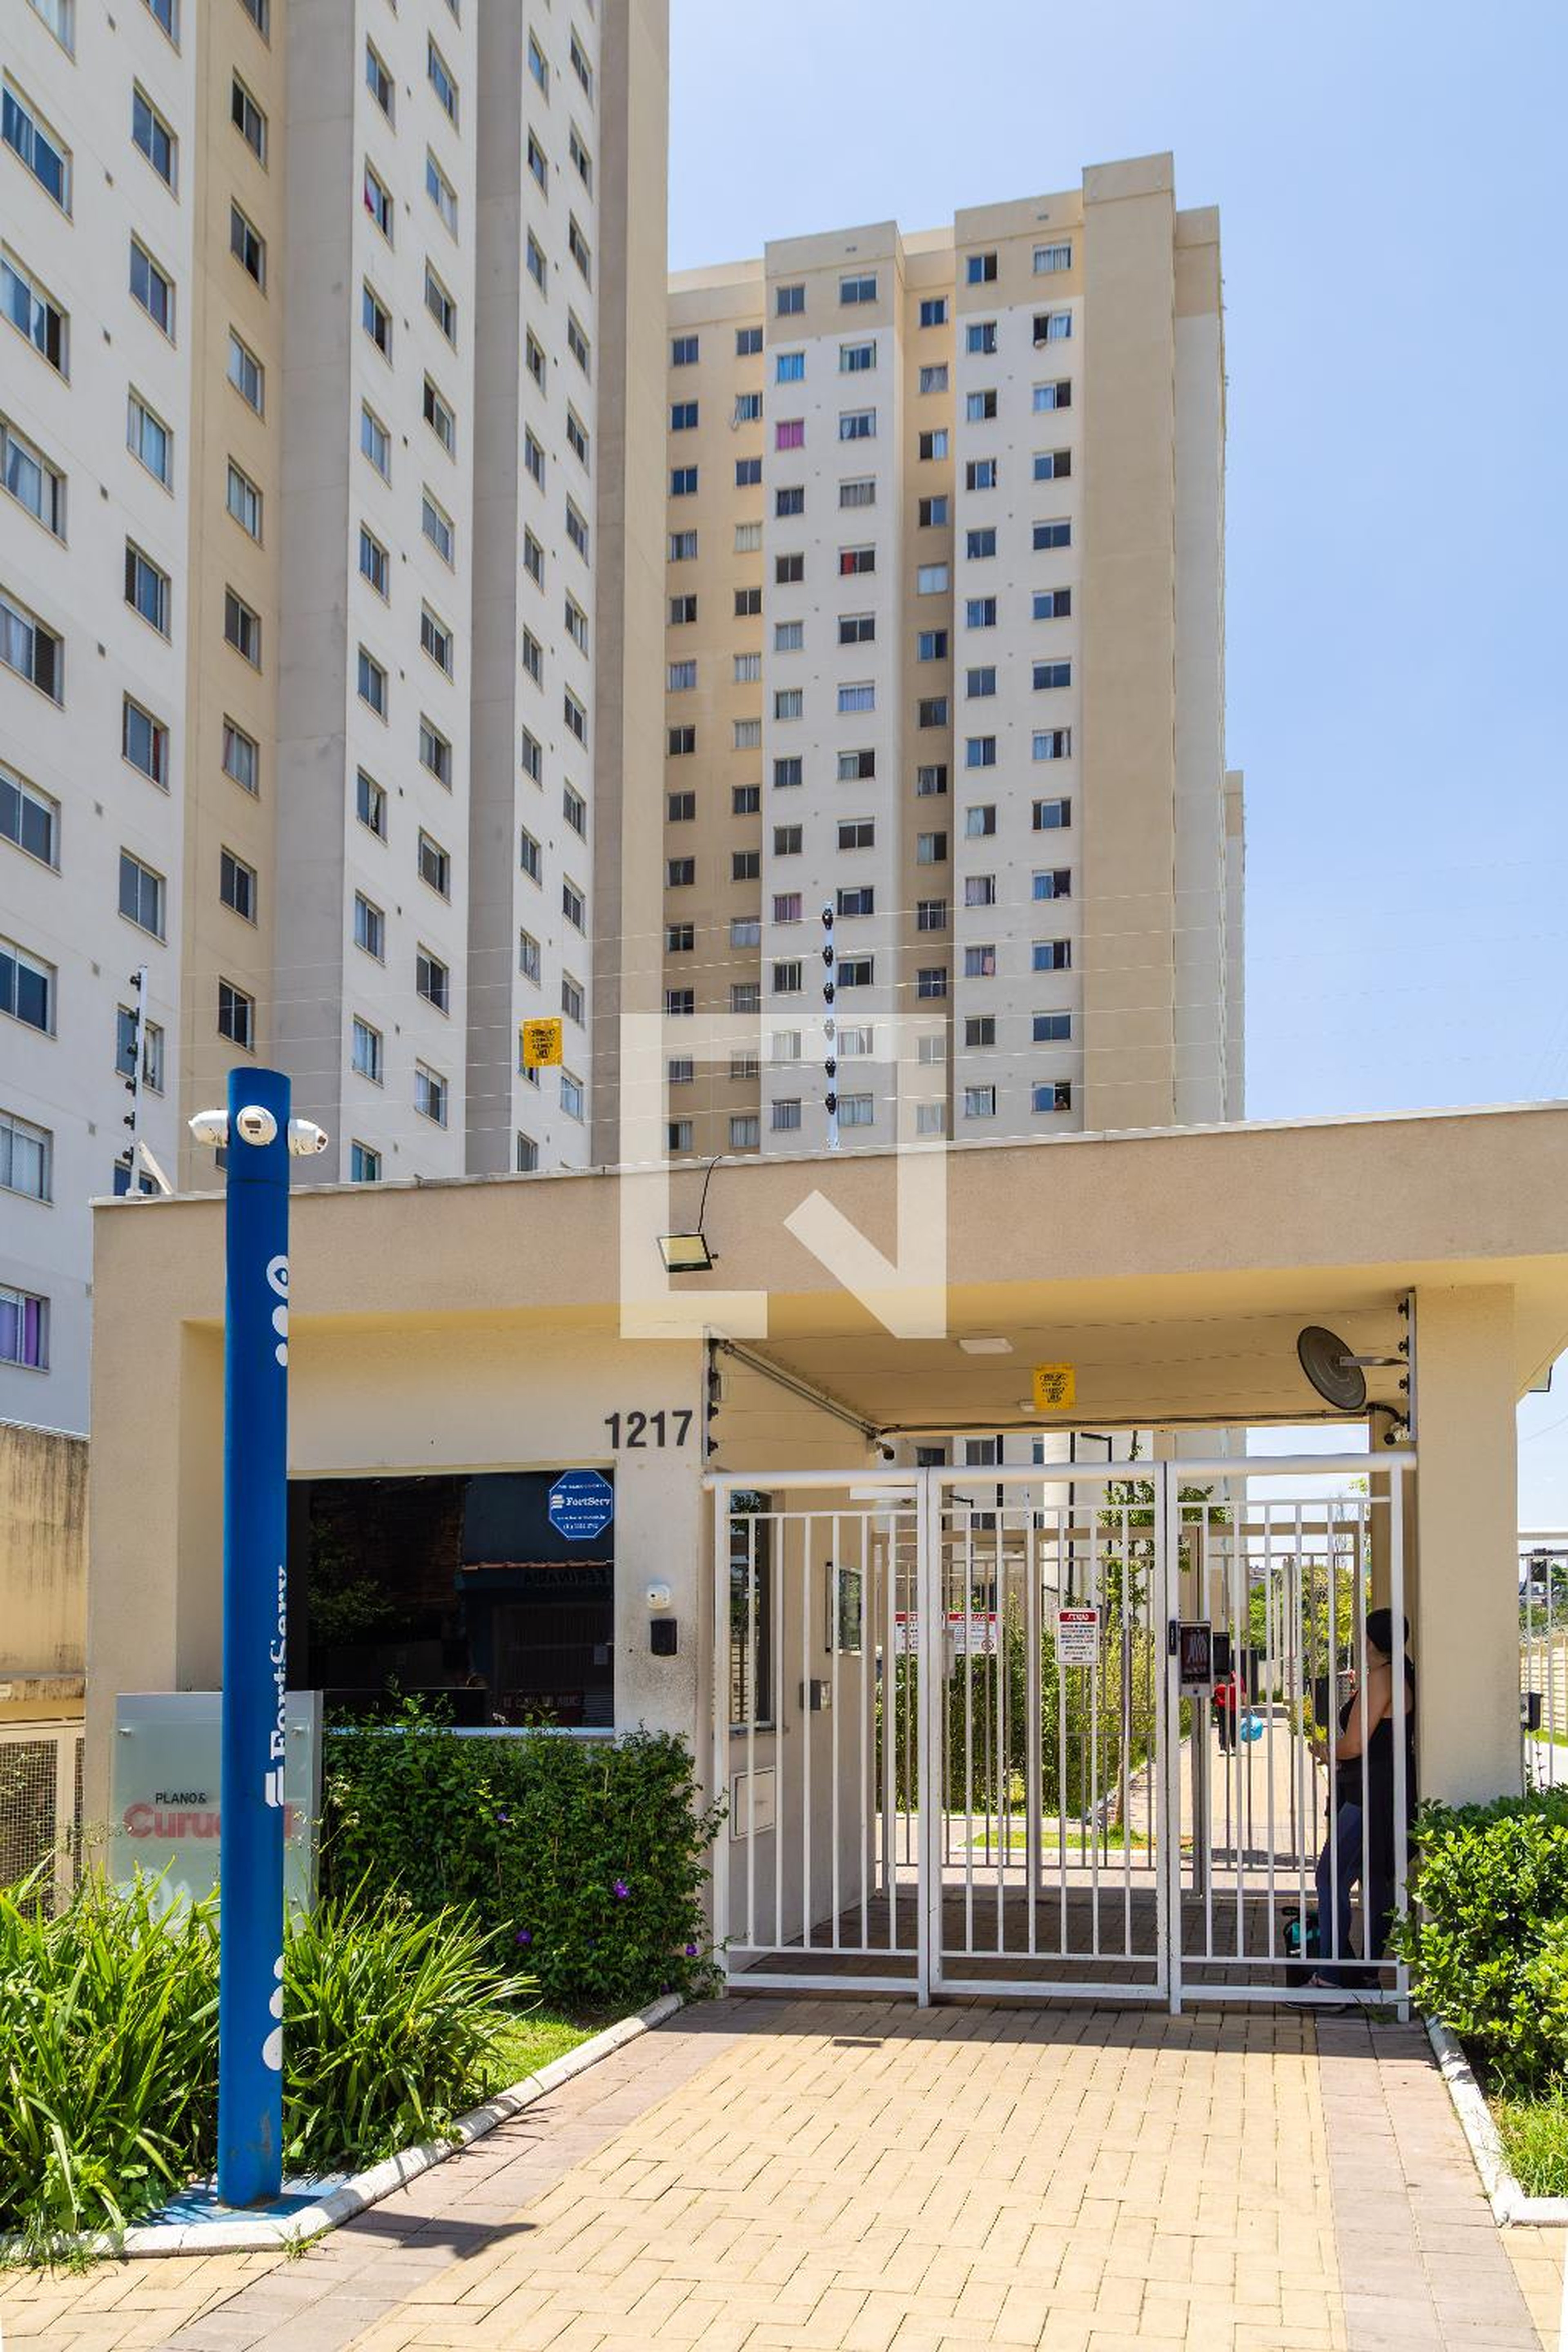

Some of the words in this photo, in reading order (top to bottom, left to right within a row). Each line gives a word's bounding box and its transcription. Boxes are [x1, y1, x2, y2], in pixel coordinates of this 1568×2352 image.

[605, 1410, 693, 1449] 1217
[566, 1497, 610, 1506] FortServ
[156, 1792, 207, 1804] PLANO&
